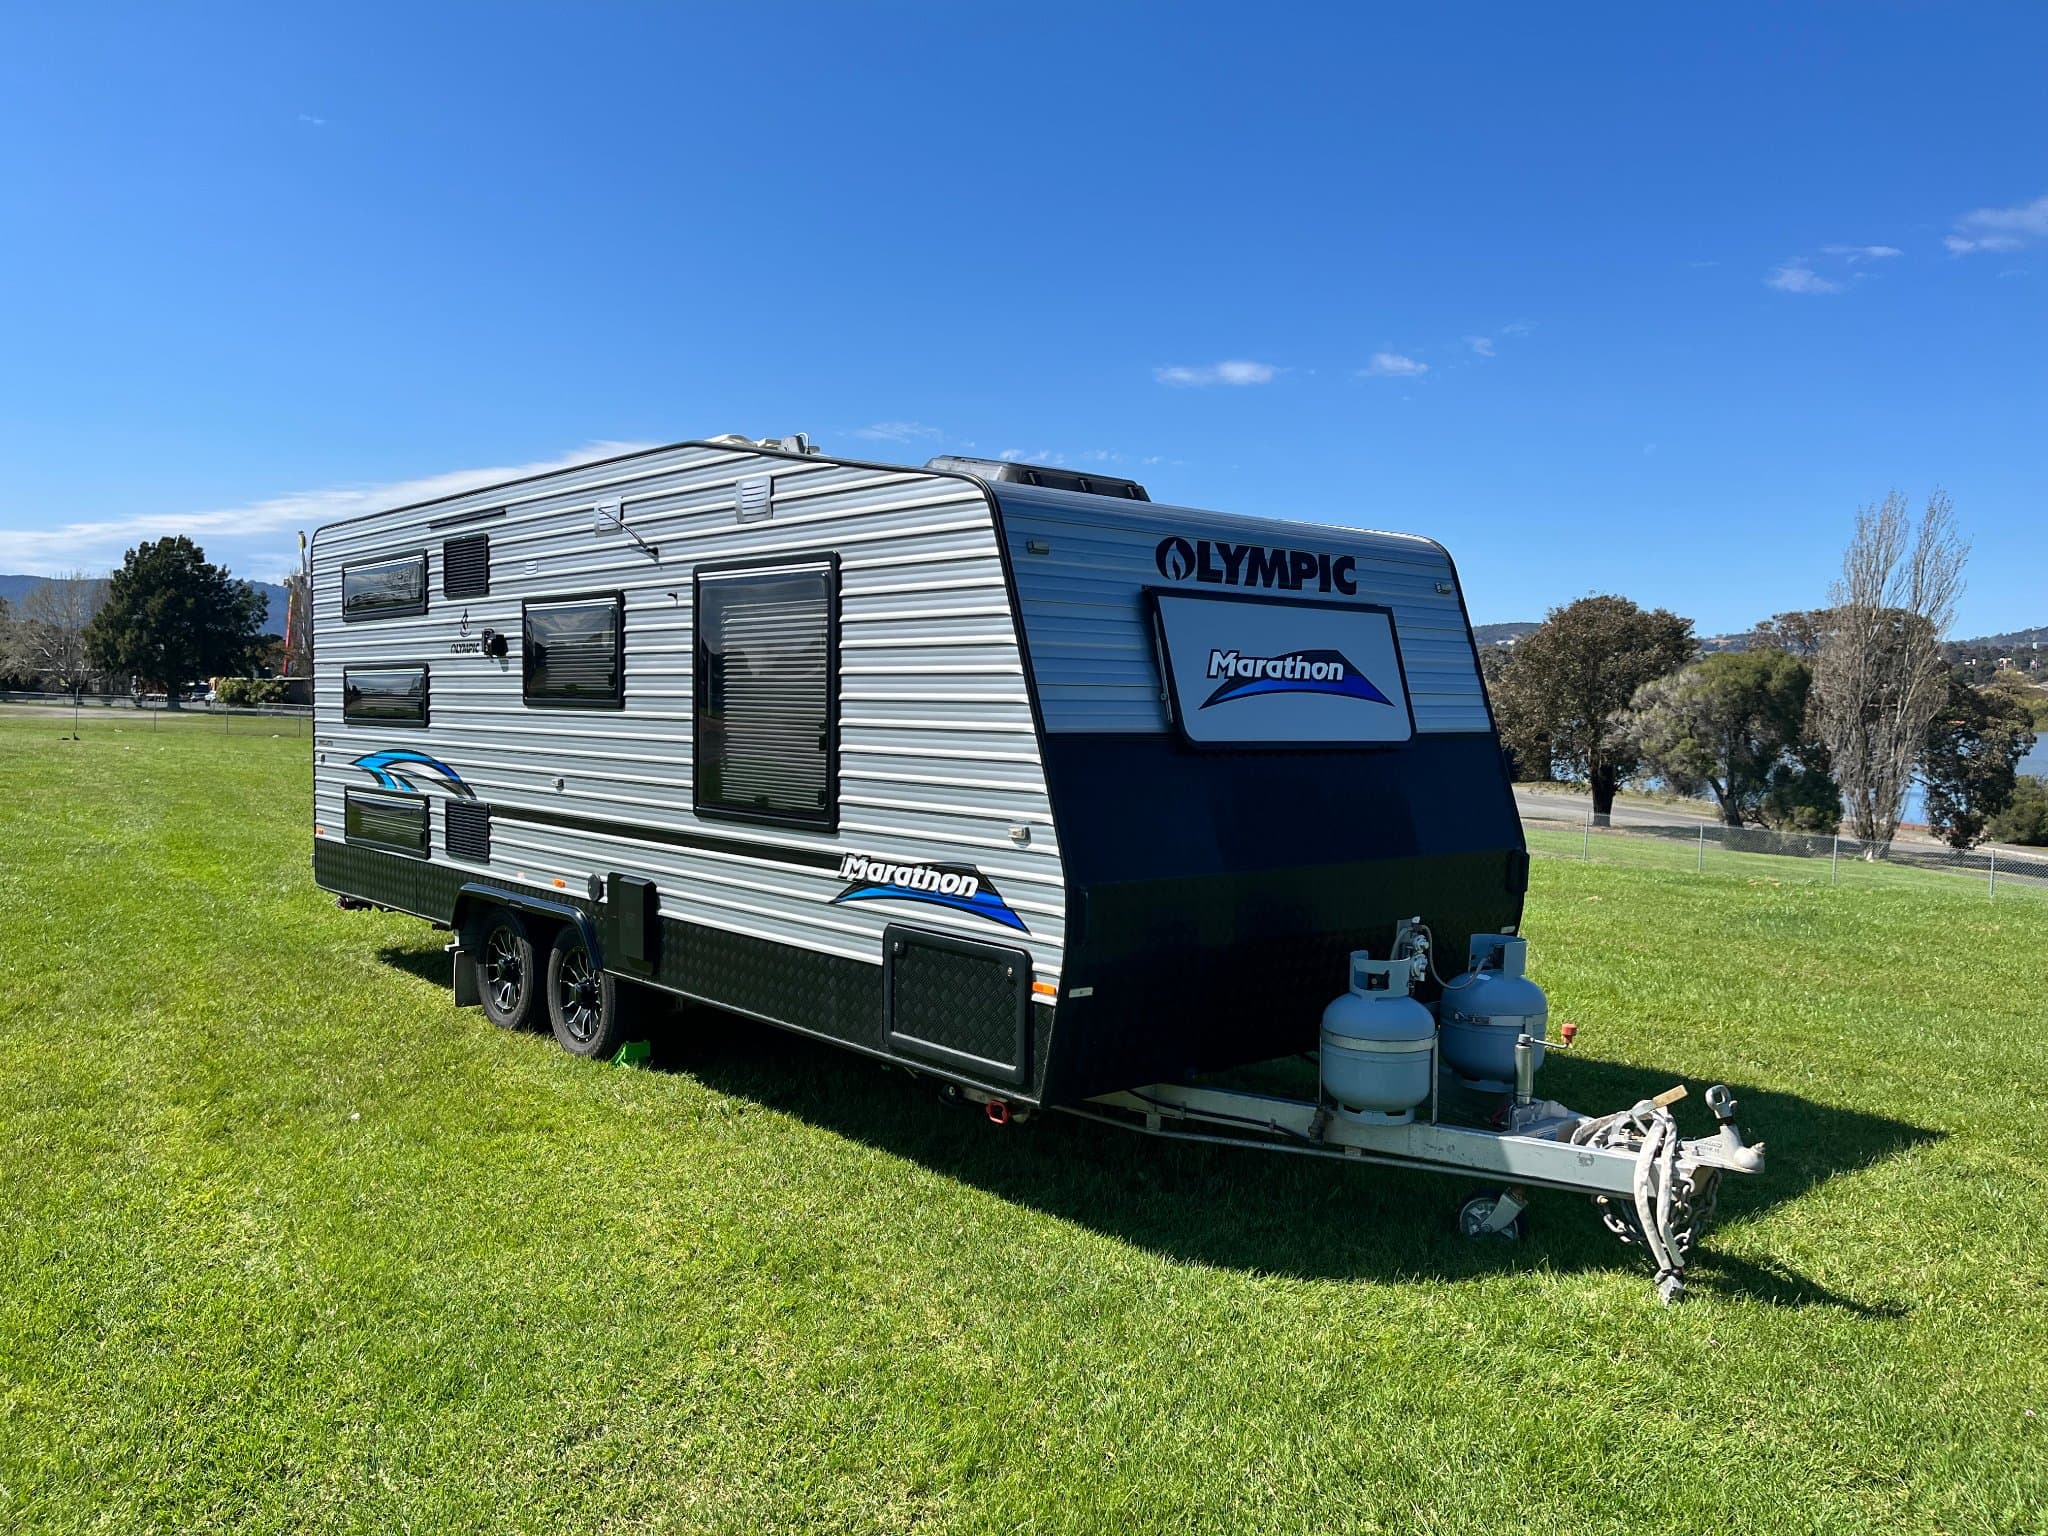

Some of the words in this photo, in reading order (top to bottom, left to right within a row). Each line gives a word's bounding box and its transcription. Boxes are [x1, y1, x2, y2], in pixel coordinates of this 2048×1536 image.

[1155, 536, 1357, 596] OLYMPIC
[1208, 650, 1344, 681] Marathon
[839, 853, 979, 898] Marathon
